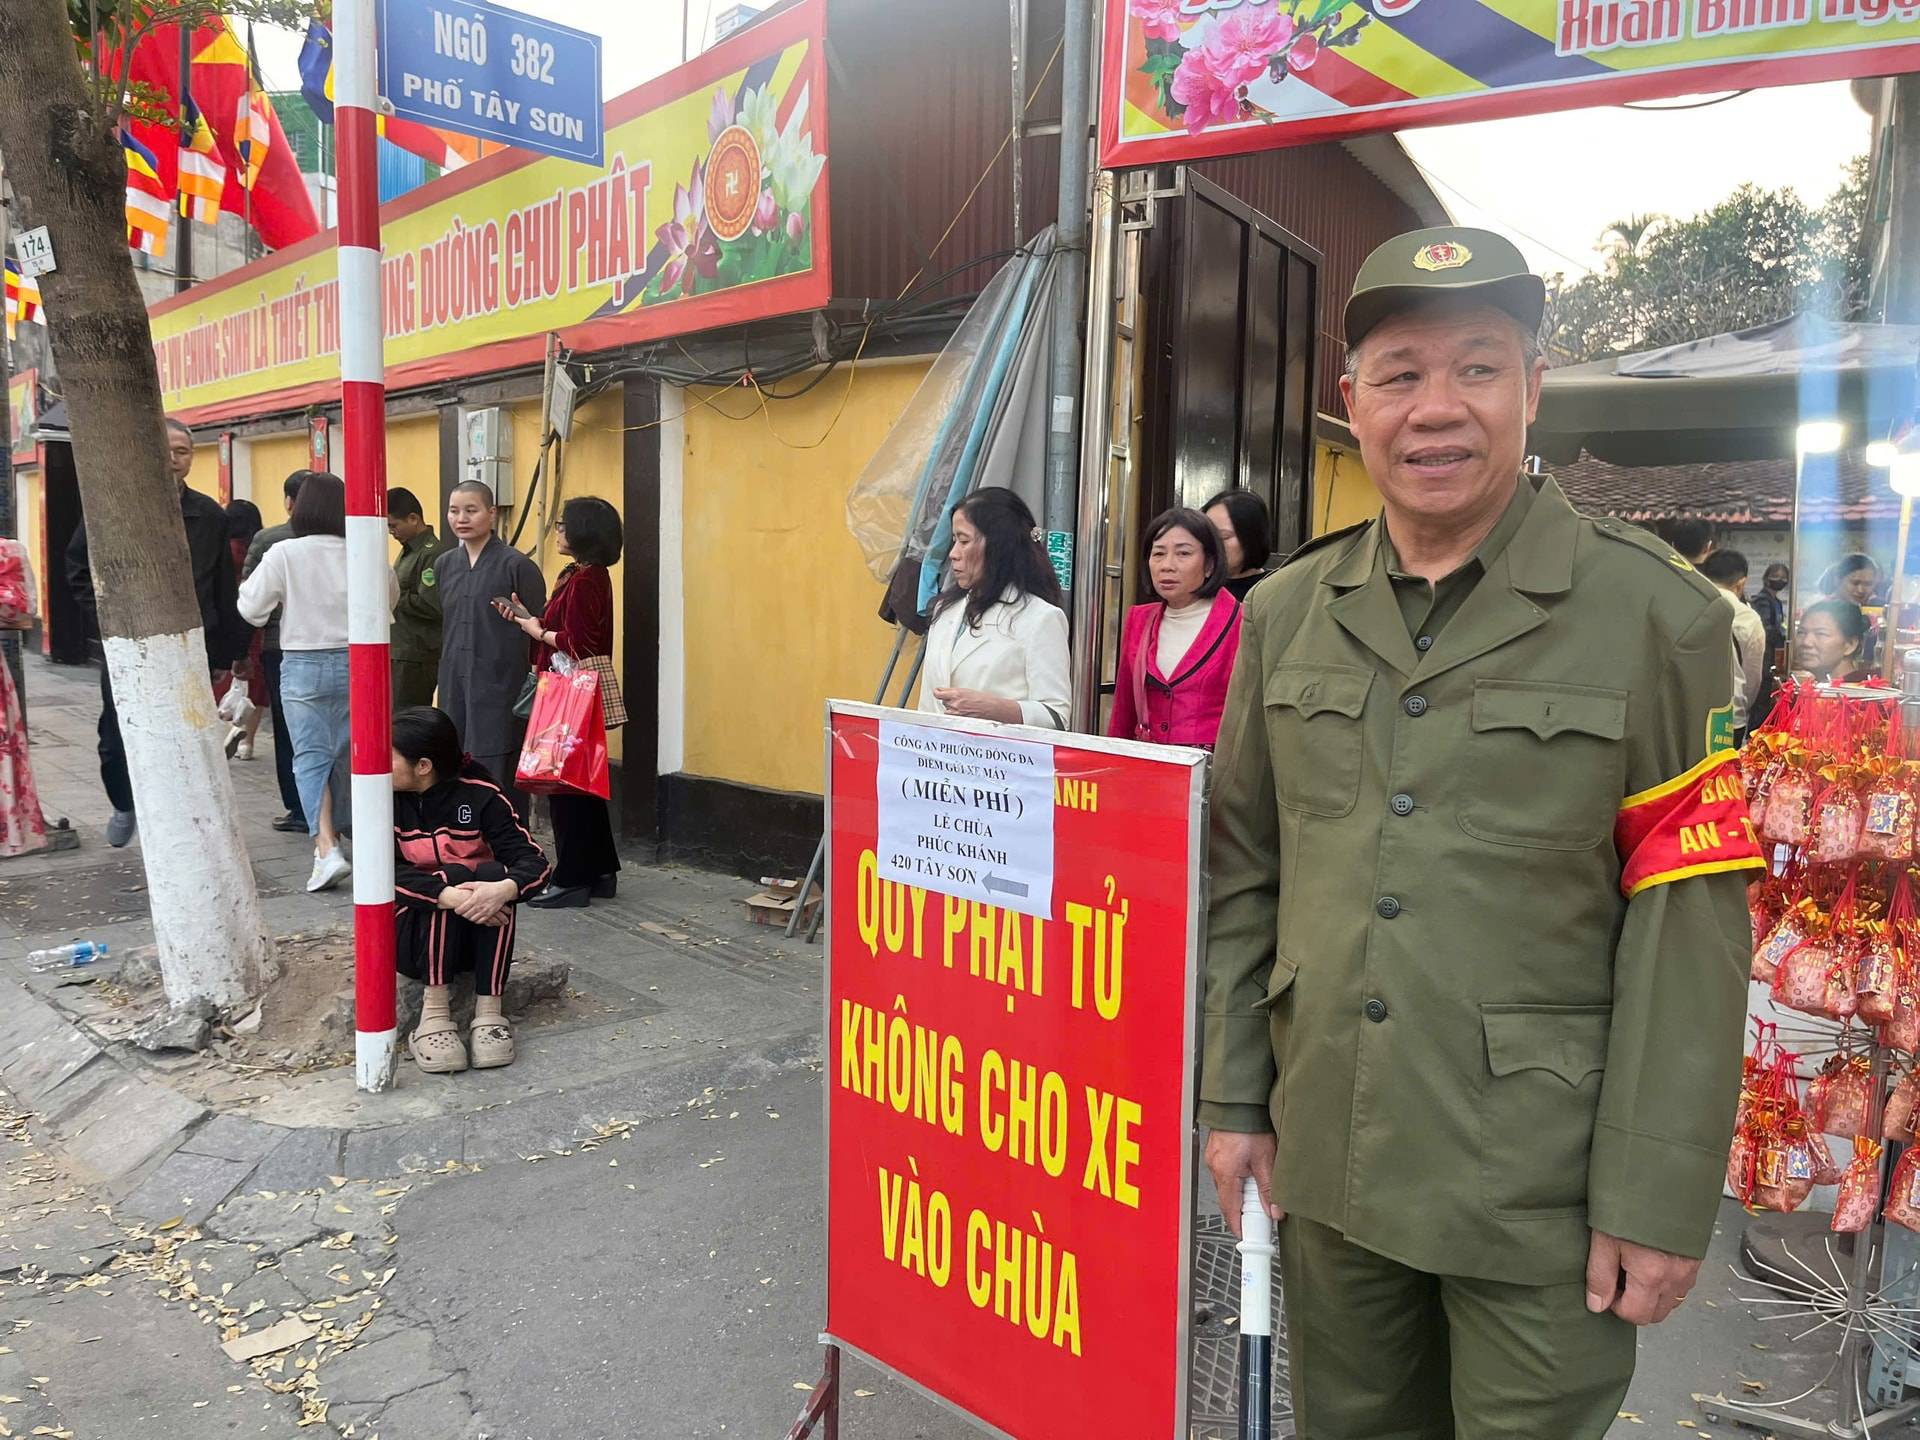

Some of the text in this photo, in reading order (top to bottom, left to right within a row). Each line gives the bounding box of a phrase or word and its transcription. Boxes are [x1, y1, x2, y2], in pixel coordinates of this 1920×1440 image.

[433, 11, 556, 86] NGÕ 382
[403, 72, 584, 142] PHỐ TÂY SƠN
[22, 236, 45, 259] 174
[183, 313, 221, 388] CHÚNG
[222, 311, 250, 378] SINH
[254, 292, 268, 370] LÀ
[271, 274, 312, 366] THIẾT
[420, 219, 500, 329] DƯỜNG
[504, 190, 564, 306] CHƯ
[567, 154, 651, 302] PHẬT
[894, 734, 922, 750] CÔNG
[924, 741, 938, 751] AN
[983, 766, 1008, 780] MÁY
[457, 804, 472, 824] C
[973, 787, 1010, 813] PHÍ
[917, 834, 1008, 866] PHÚC KHÁNH
[1679, 821, 1722, 855] AN
[890, 853, 977, 885] 420 TÂY SƠN
[1065, 874, 1129, 1021] TỬ
[841, 993, 1142, 1210] KHÔNG CHO XE
[878, 1155, 1082, 1358] VÀO CHÙA
